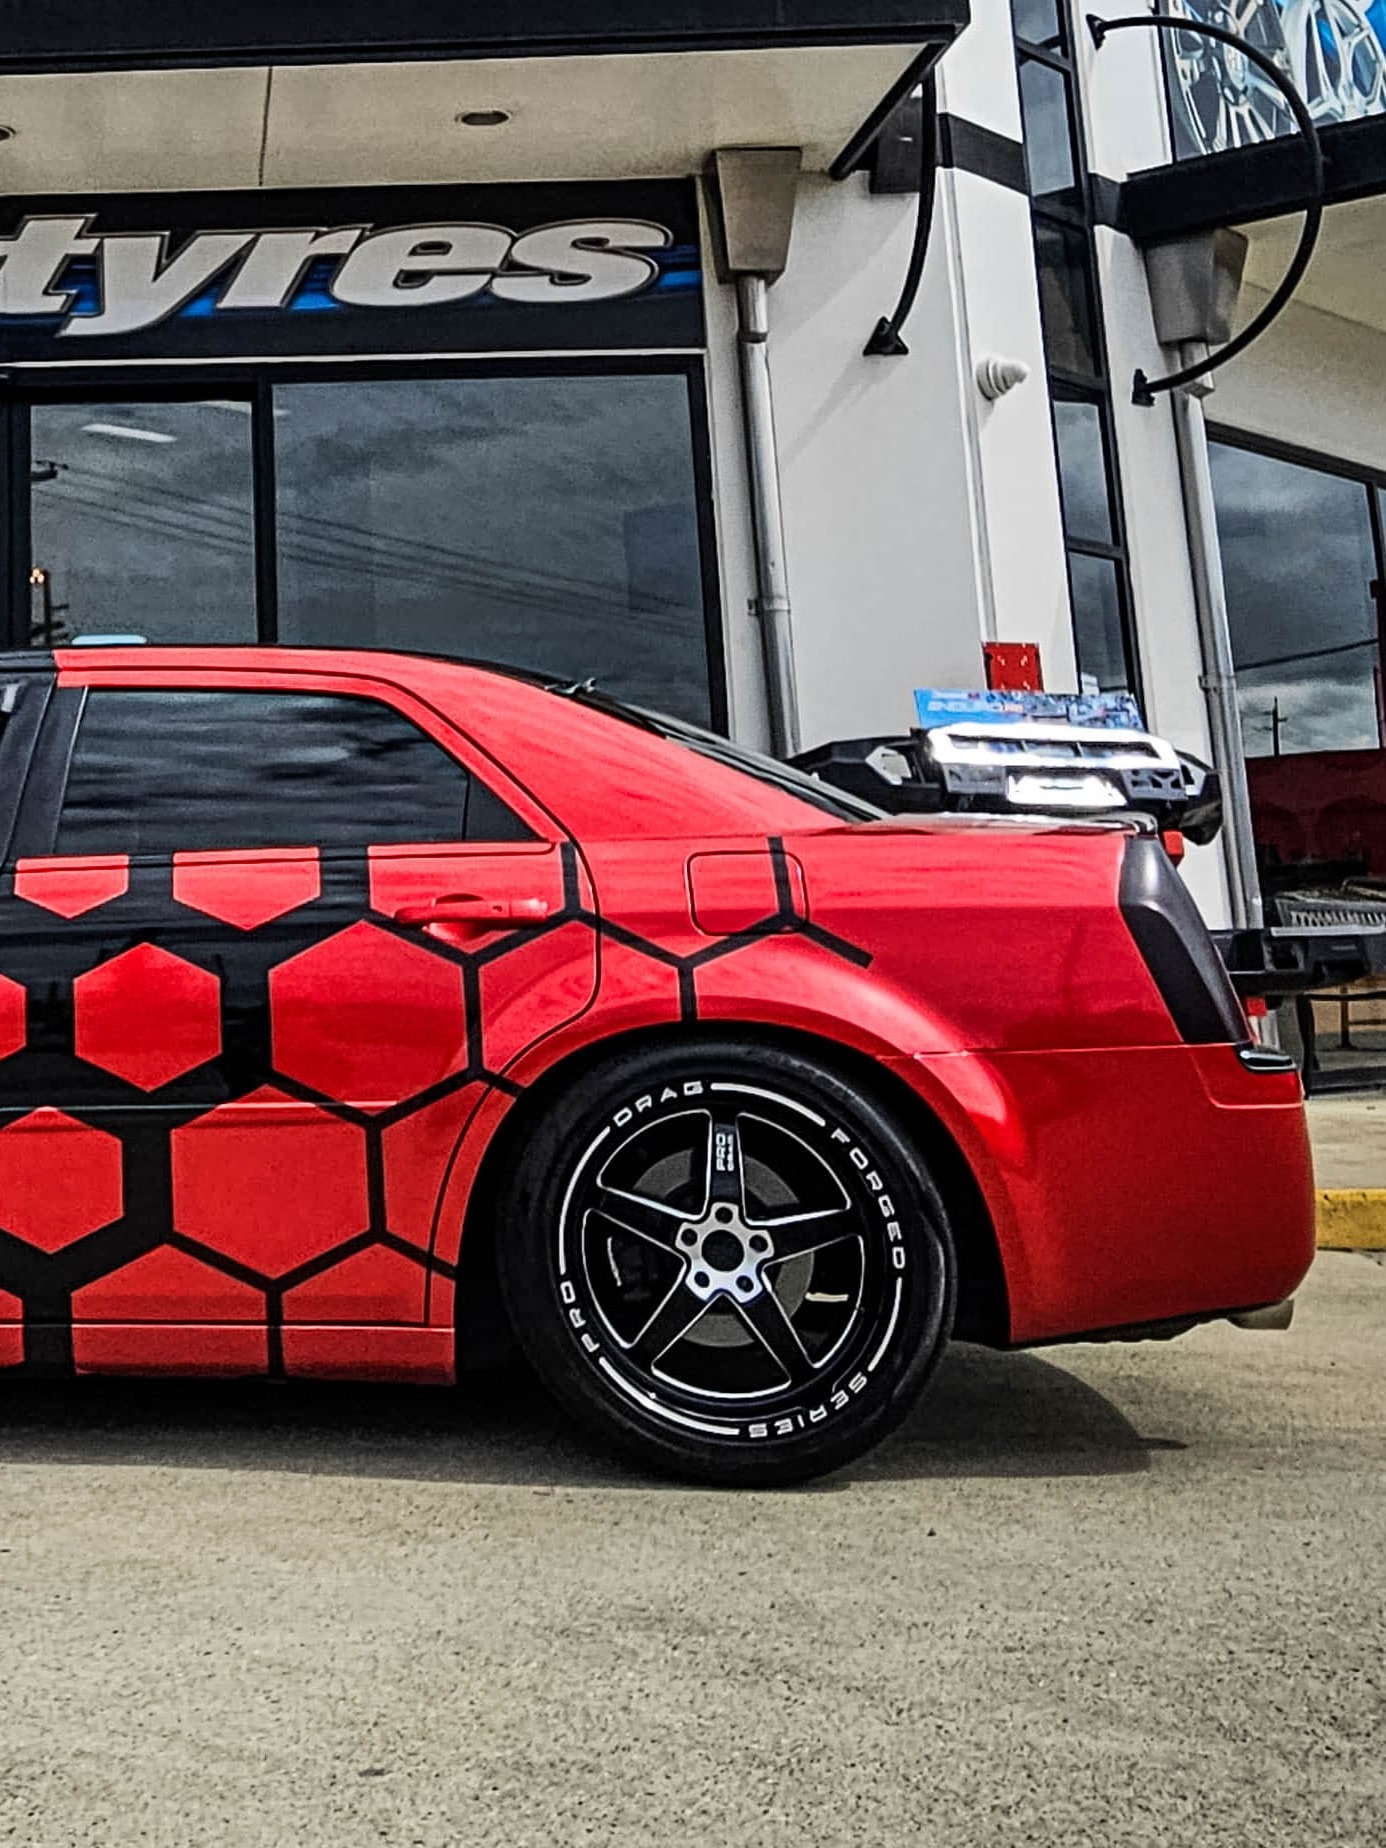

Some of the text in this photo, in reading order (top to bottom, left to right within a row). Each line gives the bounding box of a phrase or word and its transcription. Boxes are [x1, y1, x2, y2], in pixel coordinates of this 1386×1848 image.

[716, 1133, 726, 1171] PRO
[560, 1080, 906, 1438] PRO DRAG FORGED SERIES
